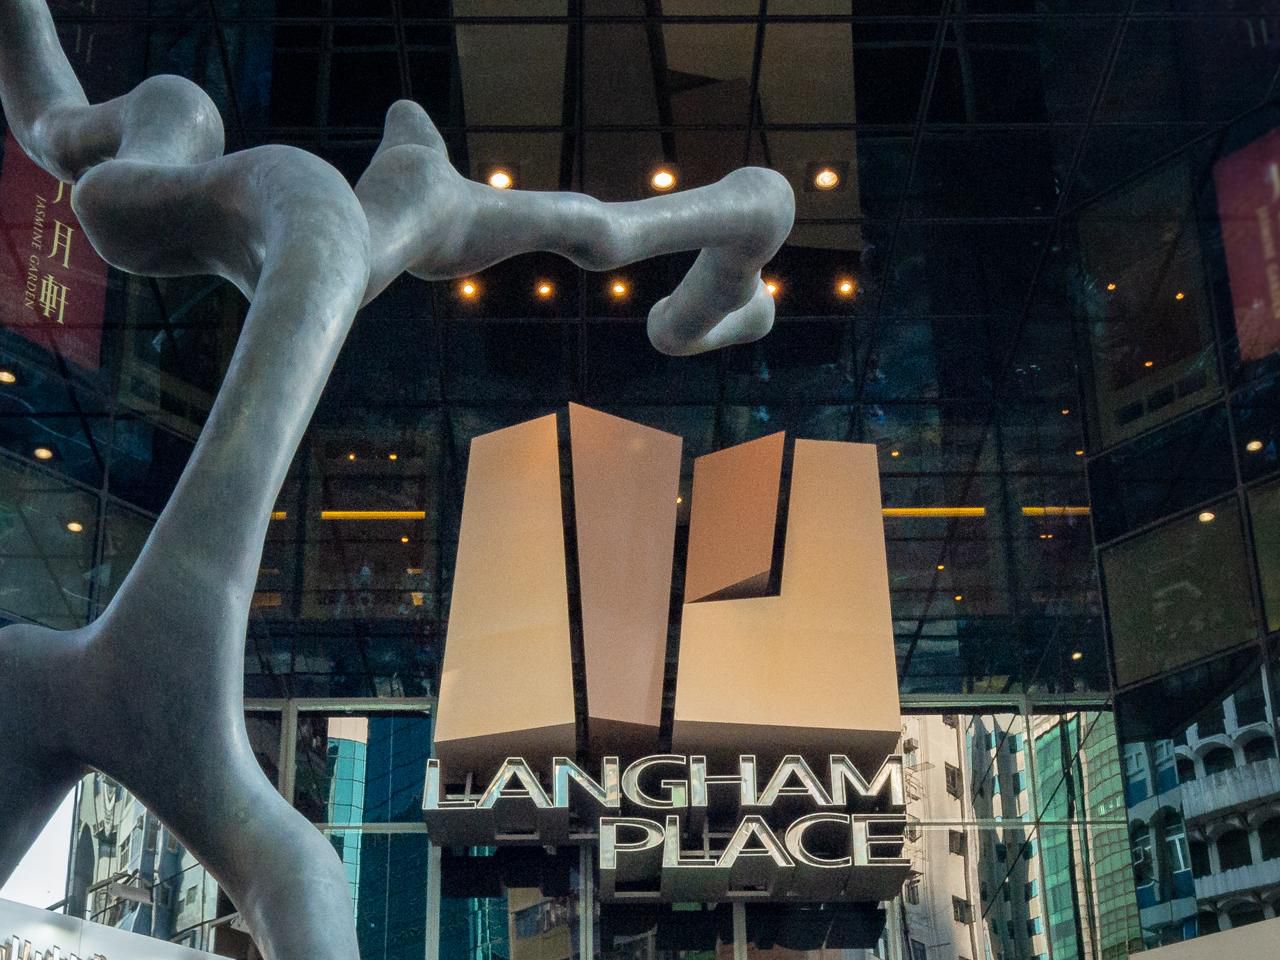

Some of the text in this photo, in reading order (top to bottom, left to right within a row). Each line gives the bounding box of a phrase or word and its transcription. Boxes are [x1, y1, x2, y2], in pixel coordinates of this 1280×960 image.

[24, 194, 47, 311] JASMINE GARDEN
[422, 753, 906, 810] LANGHAM
[598, 812, 912, 870] PLACE
